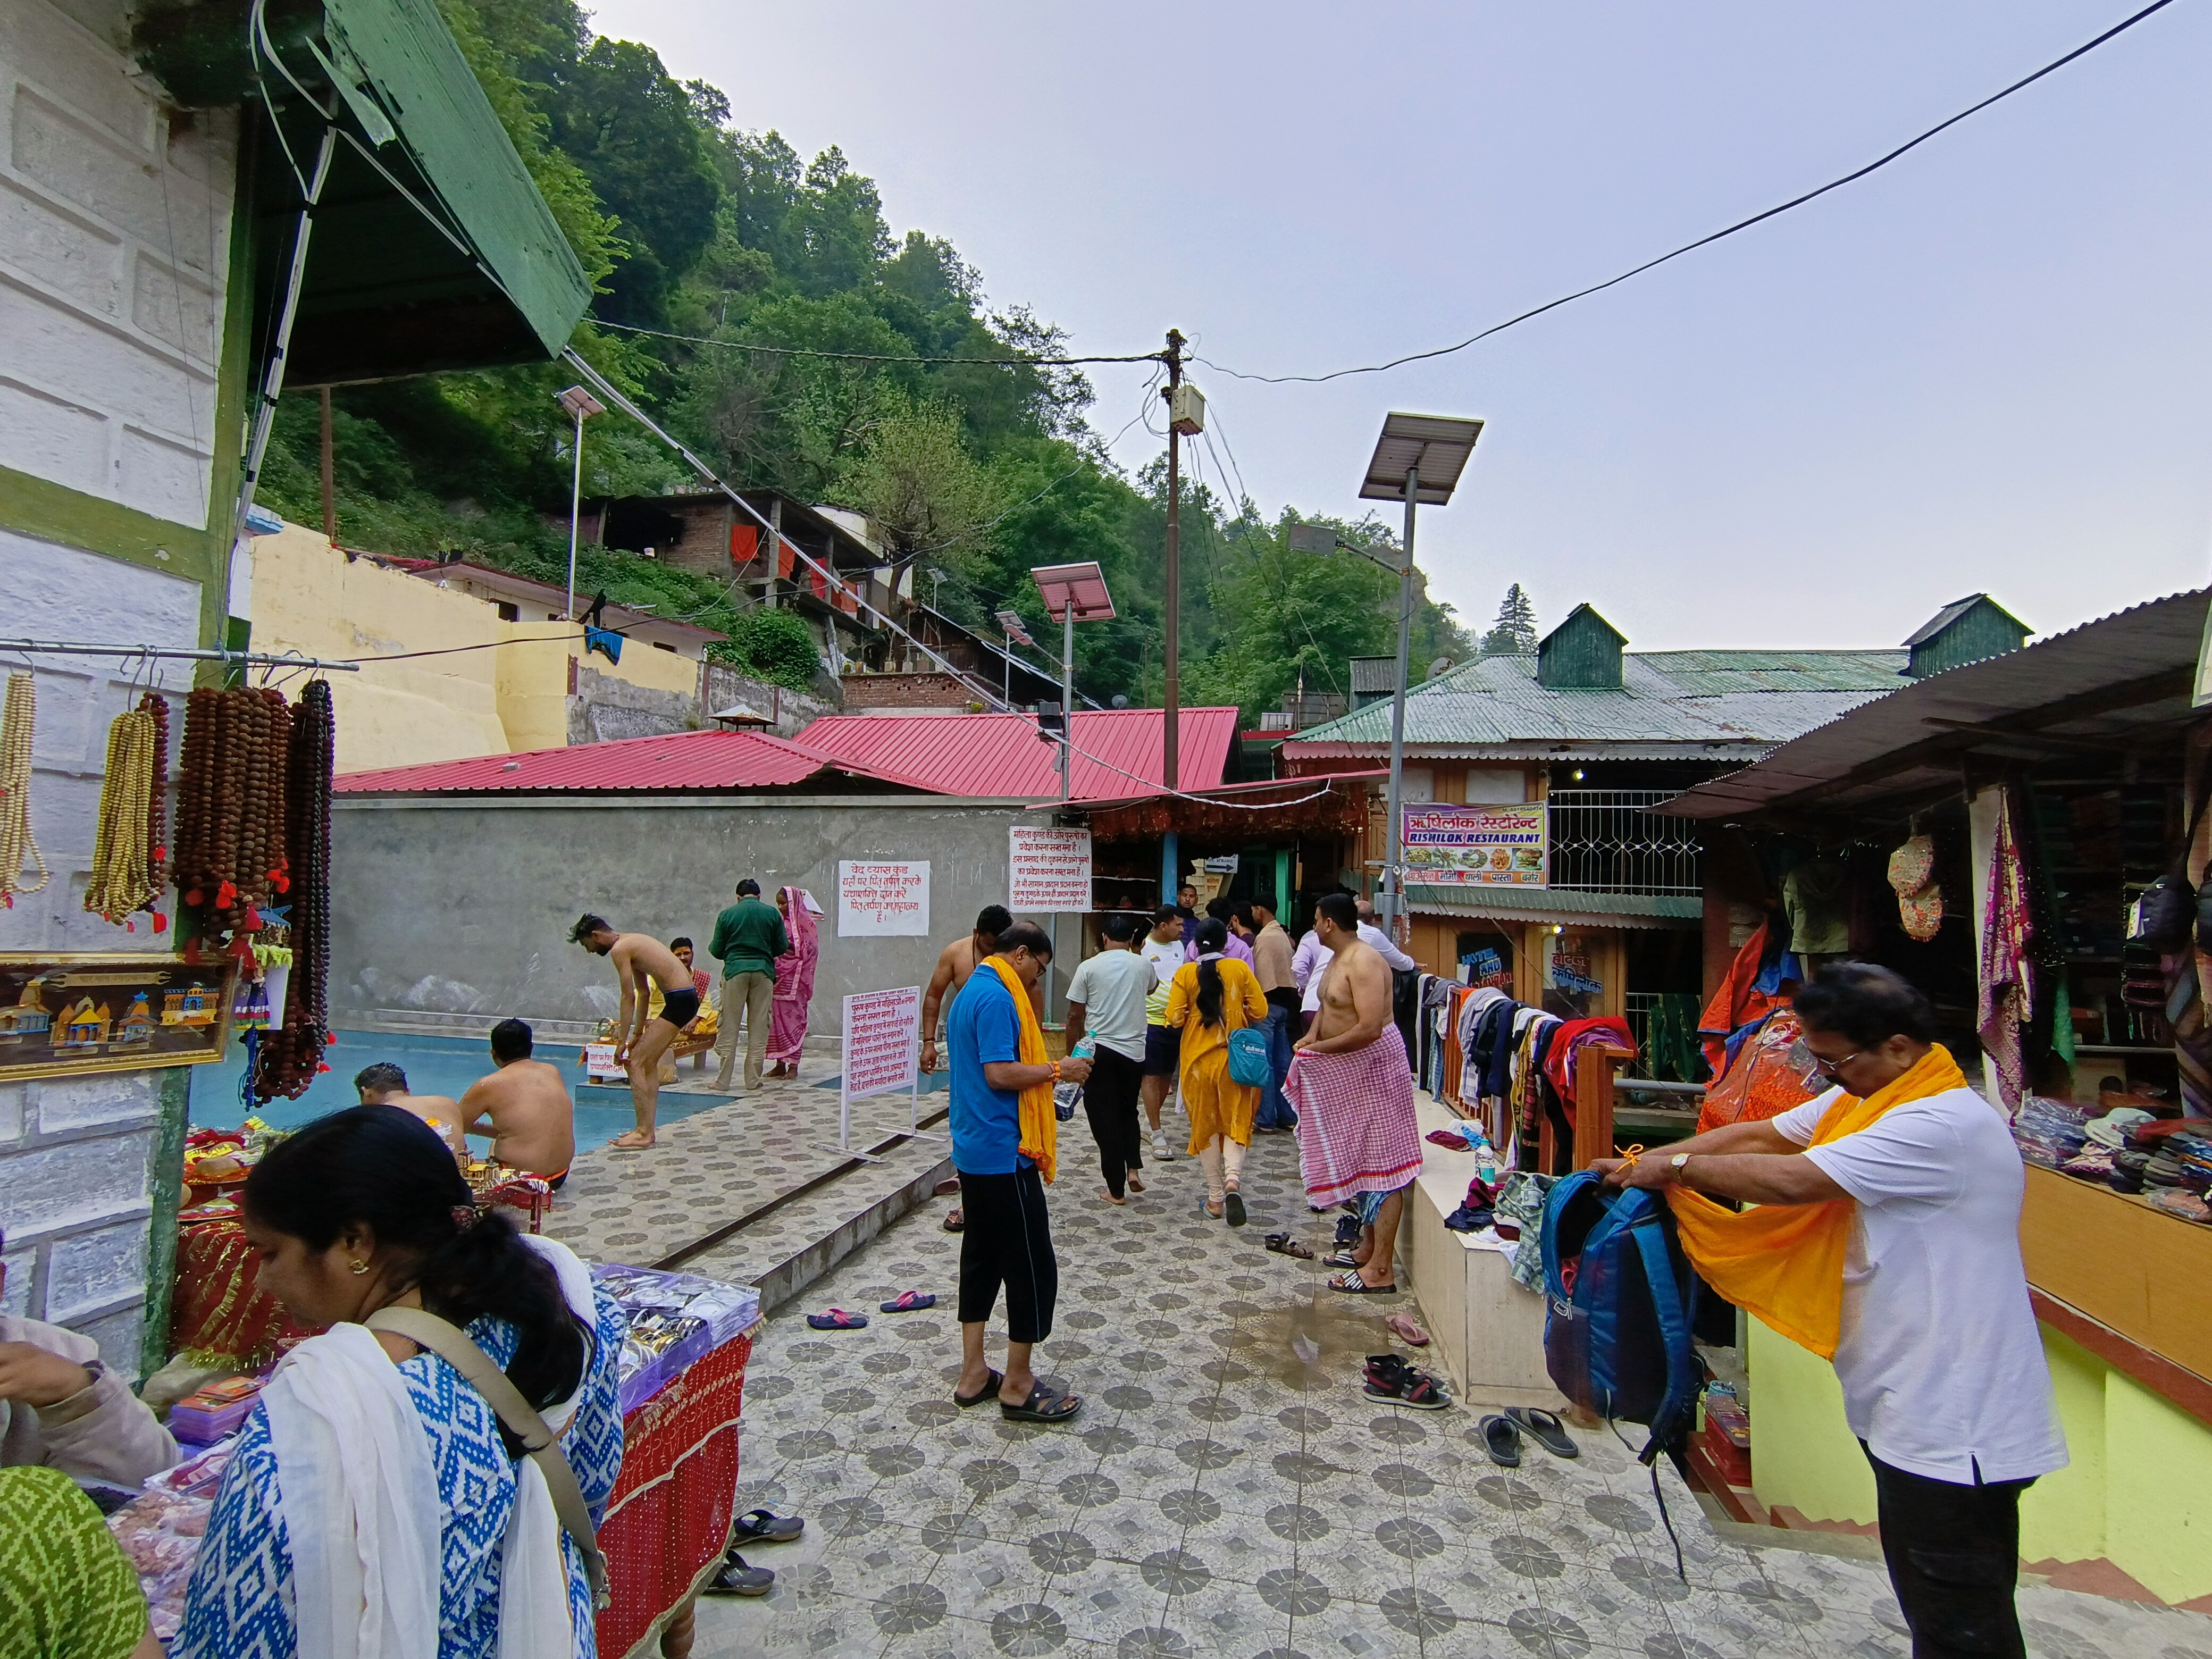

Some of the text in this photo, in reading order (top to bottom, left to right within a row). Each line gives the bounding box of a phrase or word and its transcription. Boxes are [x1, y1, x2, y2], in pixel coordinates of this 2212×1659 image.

[1410, 812, 1476, 830] ऋषिलोक
[1013, 829, 1032, 839] महिला
[1045, 829, 1052, 839] की
[1409, 833, 1540, 843] RISHILOK RESTAURANT
[1019, 841, 1033, 852] प्रवेश
[1040, 853, 1047, 863] की
[1048, 856, 1062, 866] दुकान
[851, 863, 908, 876] वेद व्यास कुंड
[1026, 866, 1040, 876] प्रवेश
[1439, 869, 1457, 881] मोमो
[1465, 871, 1482, 882] थाली
[1492, 873, 1512, 882] पास्ता
[883, 875, 900, 886] तर्पण
[902, 875, 922, 886] करके
[1013, 878, 1020, 887] जो
[1021, 878, 1027, 887] भी
[879, 890, 893, 900] दान
[894, 886, 907, 899] करें
[864, 899, 882, 911] तर्पण
[883, 902, 892, 911] का
[1462, 948, 1497, 967] HOTEL
[1552, 950, 1590, 967] होटल
[1479, 957, 1502, 976] AND
[851, 1014, 867, 1023] करना
